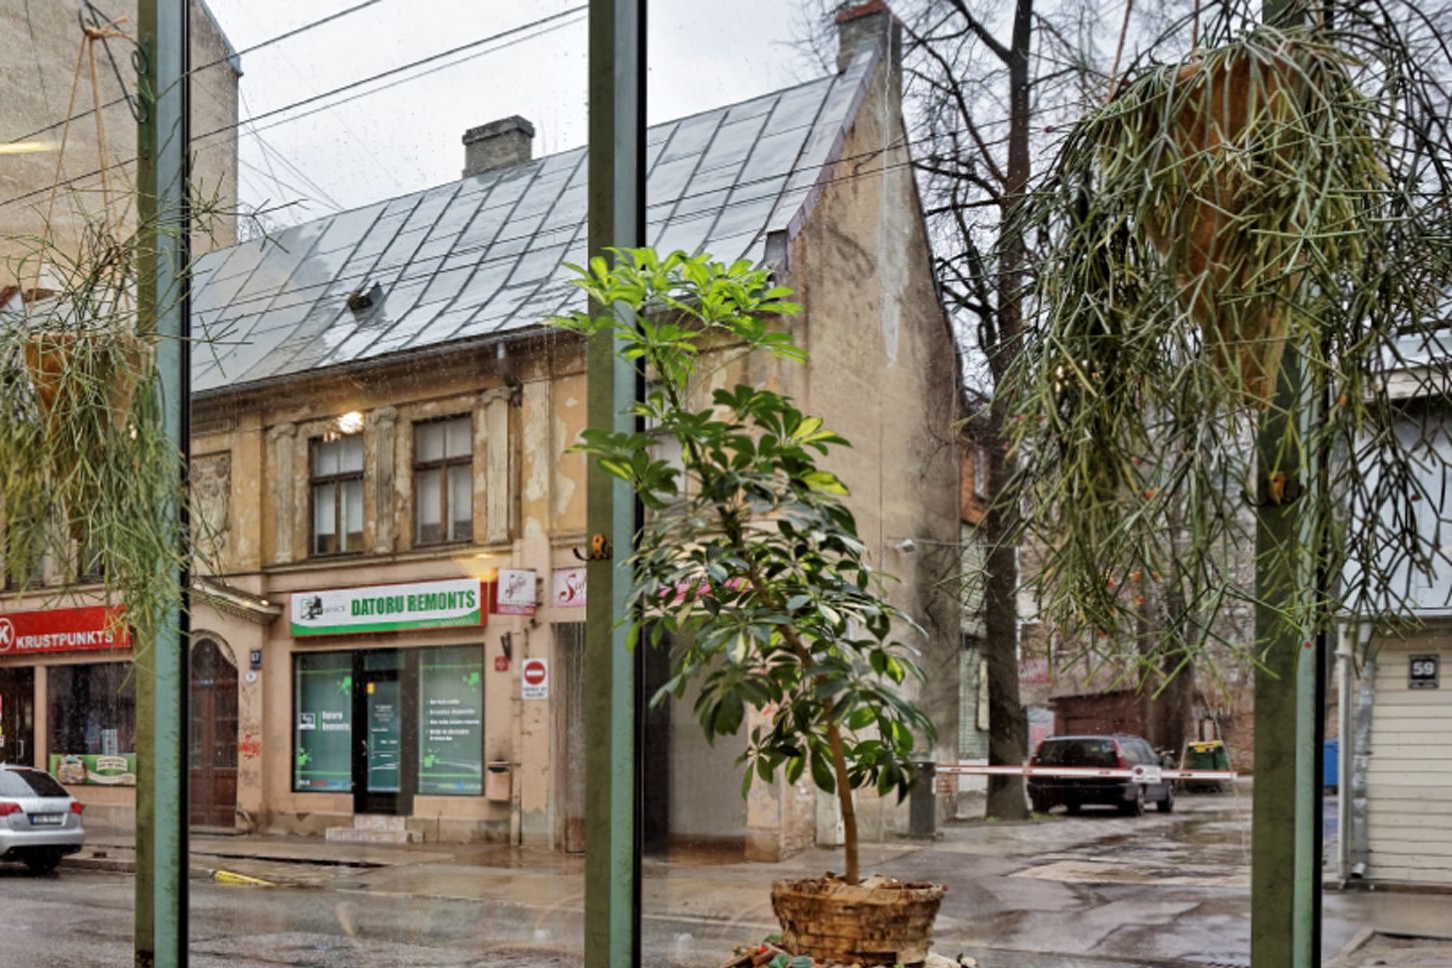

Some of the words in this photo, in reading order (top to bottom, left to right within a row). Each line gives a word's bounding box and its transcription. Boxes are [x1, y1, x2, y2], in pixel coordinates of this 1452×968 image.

[351, 594, 405, 617] DATORU
[407, 589, 476, 612] REMONTS
[16, 630, 114, 649] KRUSTPUNKTS
[1412, 661, 1436, 676] 59
